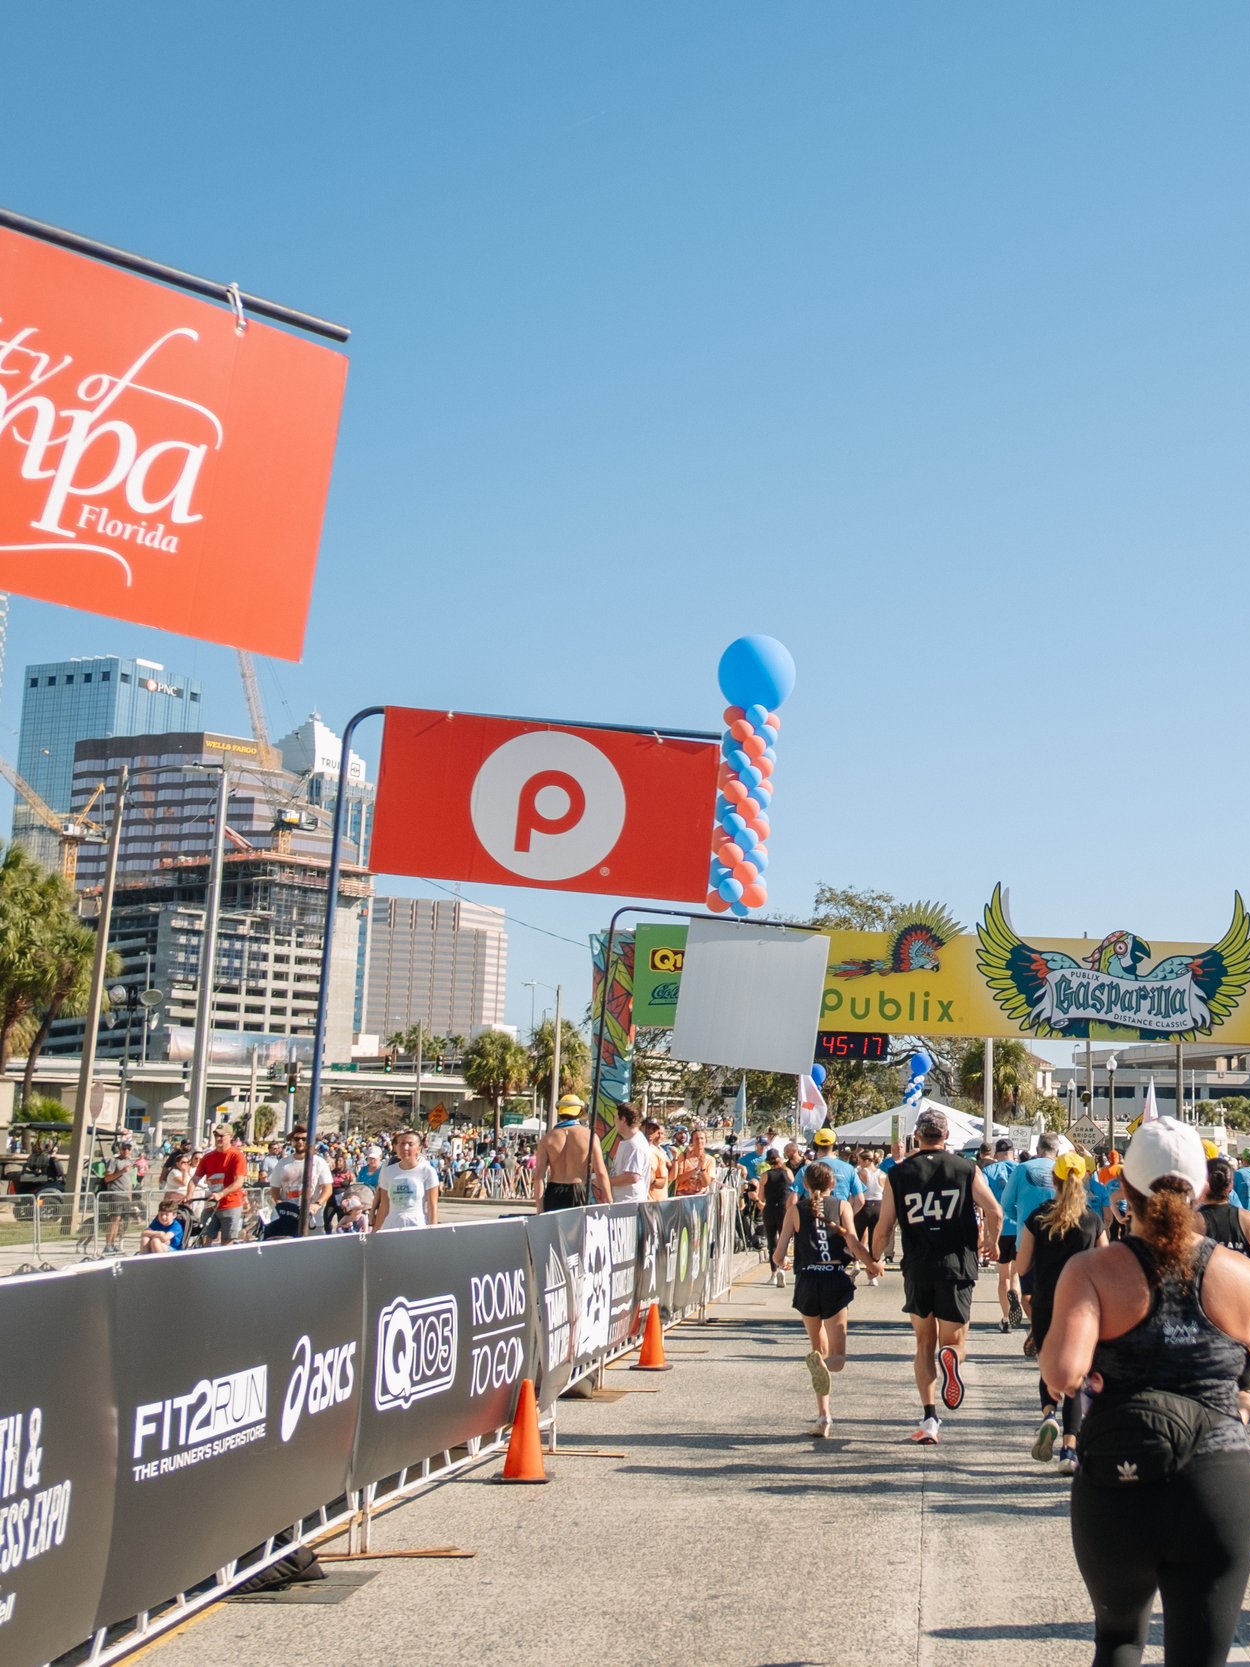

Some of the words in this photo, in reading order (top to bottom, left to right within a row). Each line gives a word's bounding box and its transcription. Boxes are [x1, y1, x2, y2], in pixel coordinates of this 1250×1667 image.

[76, 503, 179, 553] Florida
[157, 682, 178, 697] PNC
[205, 740, 232, 752] WELLS
[232, 745, 257, 755] FARGO
[321, 757, 340, 770] TRUI
[654, 949, 683, 971] Q1
[1070, 971, 1101, 982] PUBLIX
[820, 987, 954, 1023] Publix
[1054, 974, 1188, 1020] Gasparilla
[1113, 1013, 1154, 1027] DISTANCE
[1155, 1020, 1188, 1028] CLASSIC
[904, 1188, 960, 1225] 247
[470, 1268, 526, 1326] ROOMS
[384, 1306, 453, 1397] Q105
[470, 1344, 492, 1398] TO
[492, 1336, 520, 1389] GO
[308, 1341, 357, 1415] asics
[132, 1364, 268, 1459] FIT2RUN
[23, 1407, 43, 1488] &
[132, 1461, 161, 1482] THE
[160, 1444, 213, 1475] RUNNER'S
[212, 1423, 267, 1456] SUPERSTORE
[26, 1480, 72, 1560] EXPO
